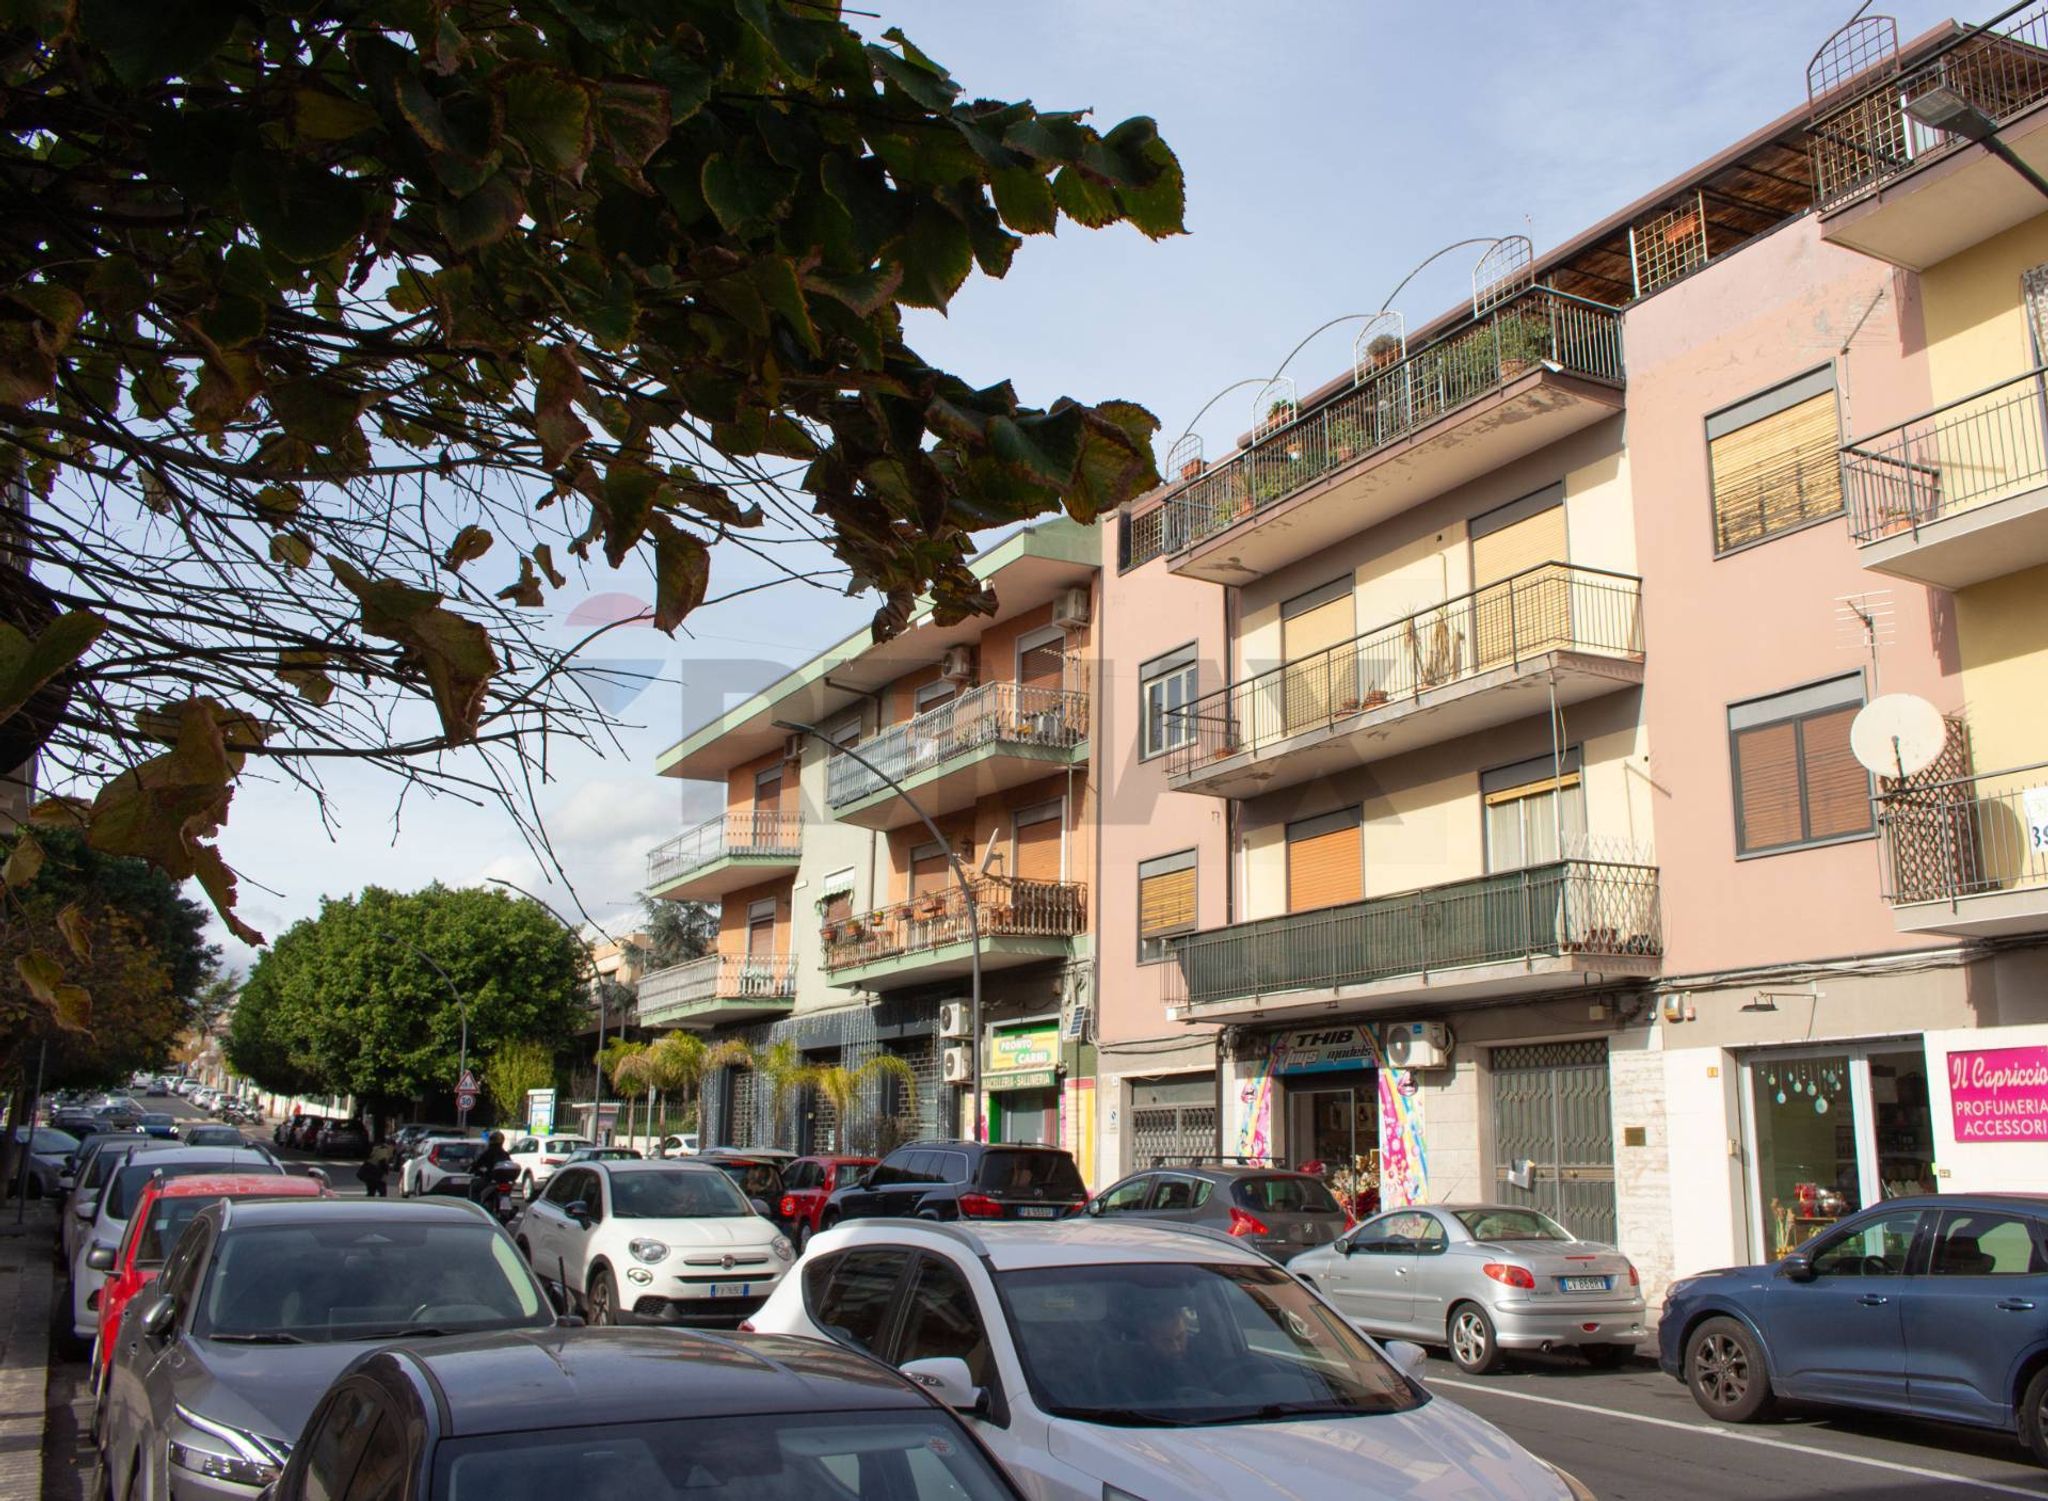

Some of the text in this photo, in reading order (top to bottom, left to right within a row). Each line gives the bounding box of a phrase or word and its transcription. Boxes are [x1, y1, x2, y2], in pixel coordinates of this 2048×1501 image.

[1297, 1029, 1353, 1047] THIB
[1971, 1056, 2048, 1096] Capriccio
[1956, 1099, 2048, 1116] PROFUMERIA
[1964, 1119, 2048, 1136] ACCESSORI
